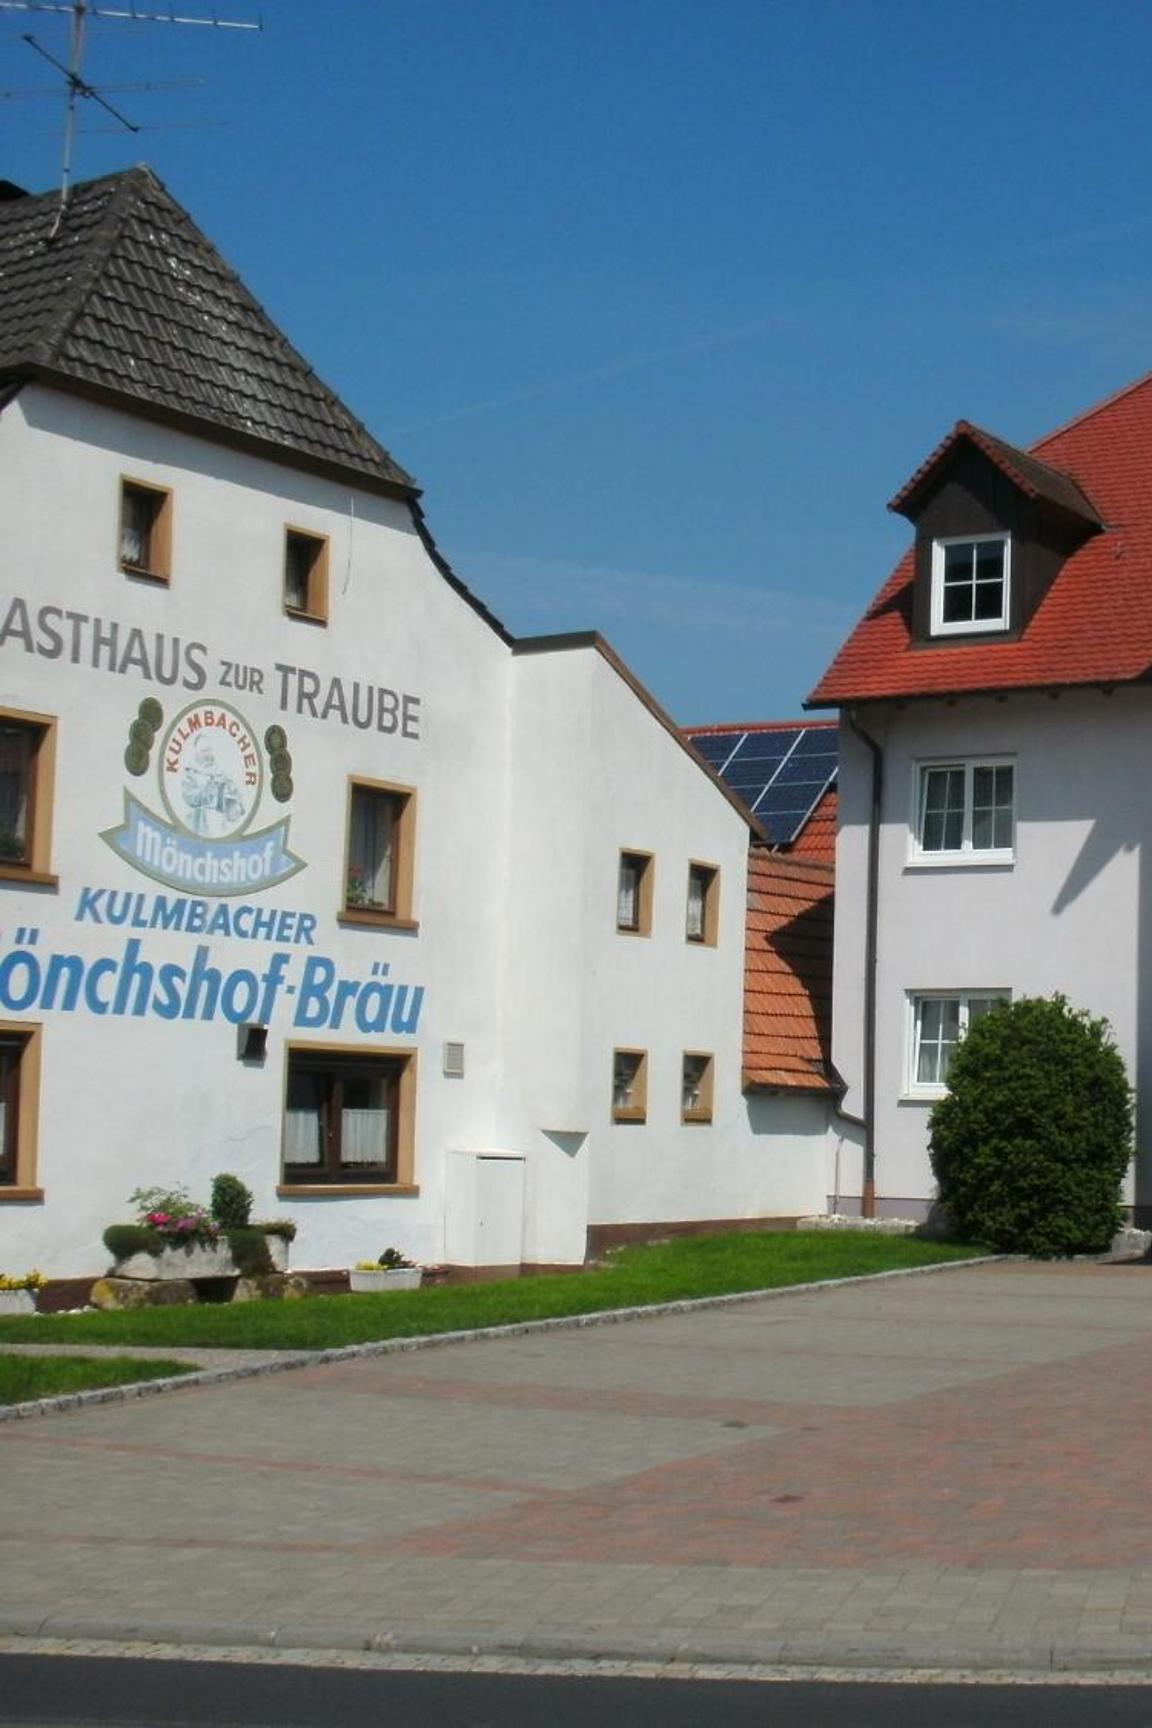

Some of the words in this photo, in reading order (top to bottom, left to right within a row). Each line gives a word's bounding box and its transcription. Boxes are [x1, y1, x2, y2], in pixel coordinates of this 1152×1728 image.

[0, 597, 208, 692] ASTHAUS
[219, 660, 265, 695] ZUR
[274, 662, 422, 741] TRAUBE
[165, 710, 258, 787] KULMBACHER
[74, 886, 318, 946] KULMBACHER
